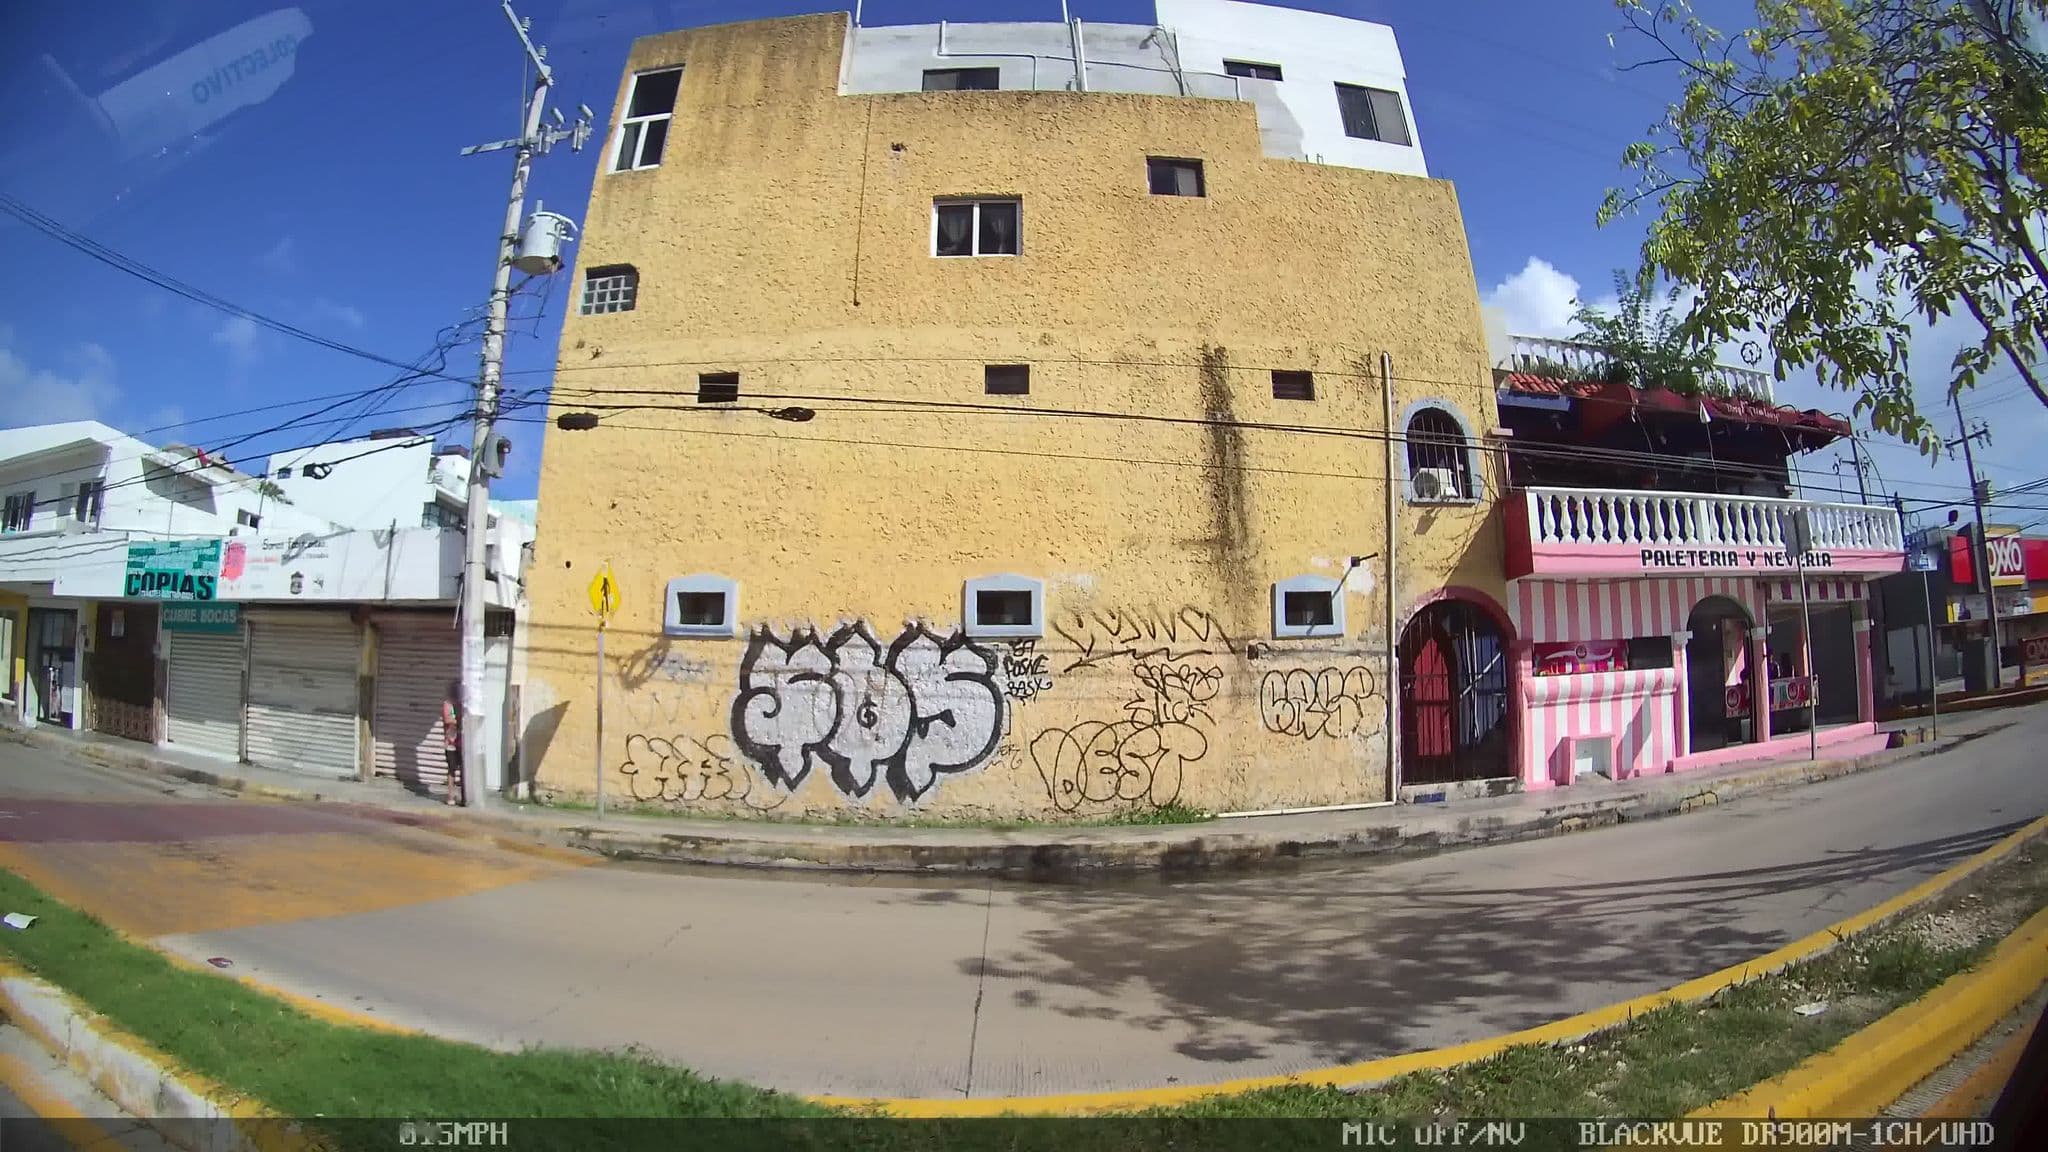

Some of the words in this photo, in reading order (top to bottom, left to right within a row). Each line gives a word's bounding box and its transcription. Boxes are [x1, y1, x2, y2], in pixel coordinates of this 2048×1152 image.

[1641, 549, 1739, 566] PALETERIA
[1746, 551, 1756, 566] Y
[1986, 535, 2022, 576] OXXO
[127, 571, 214, 600] COPIAS
